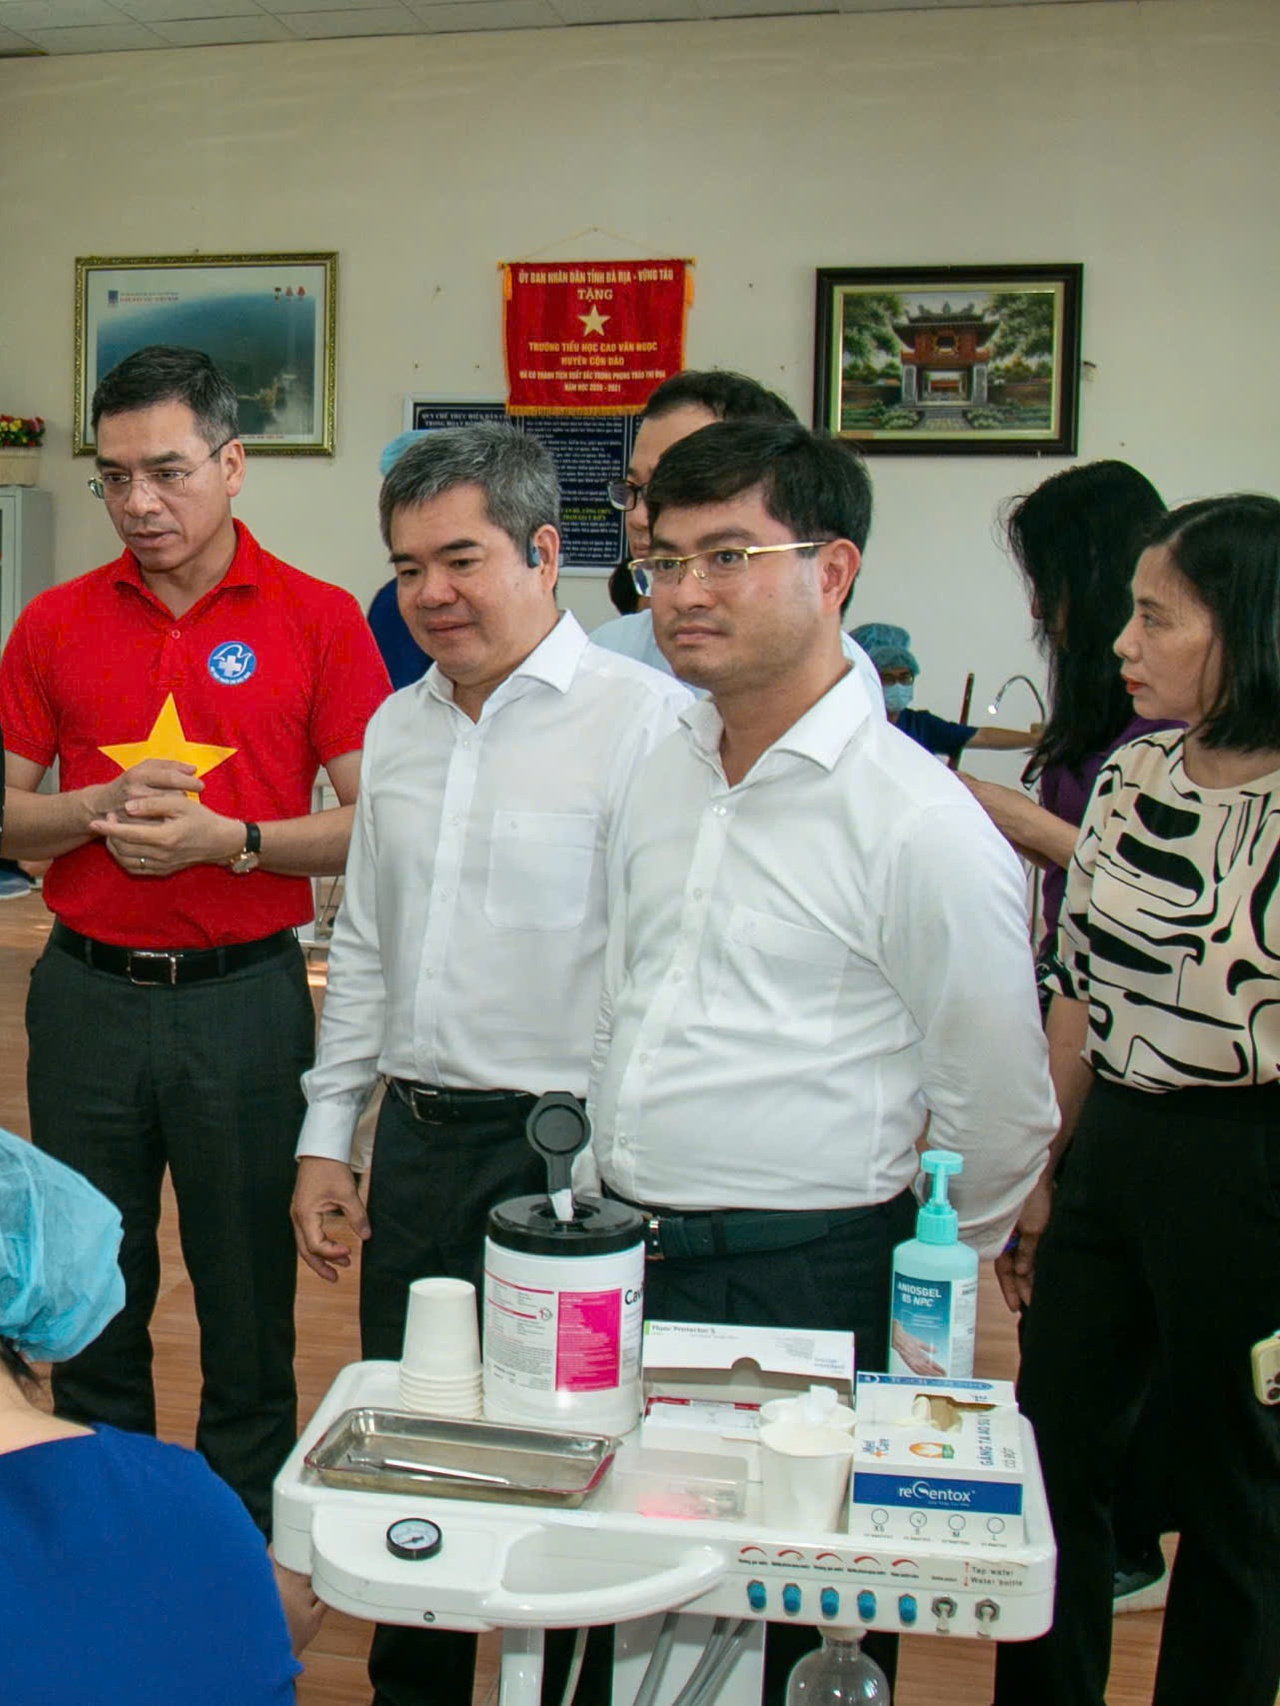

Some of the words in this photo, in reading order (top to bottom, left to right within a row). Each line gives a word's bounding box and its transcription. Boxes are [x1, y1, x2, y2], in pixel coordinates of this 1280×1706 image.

[577, 287, 613, 303] TẶNG
[600, 342, 617, 352] CAO
[897, 1282, 942, 1299] ANIOSGEL
[913, 1296, 934, 1308] NPC
